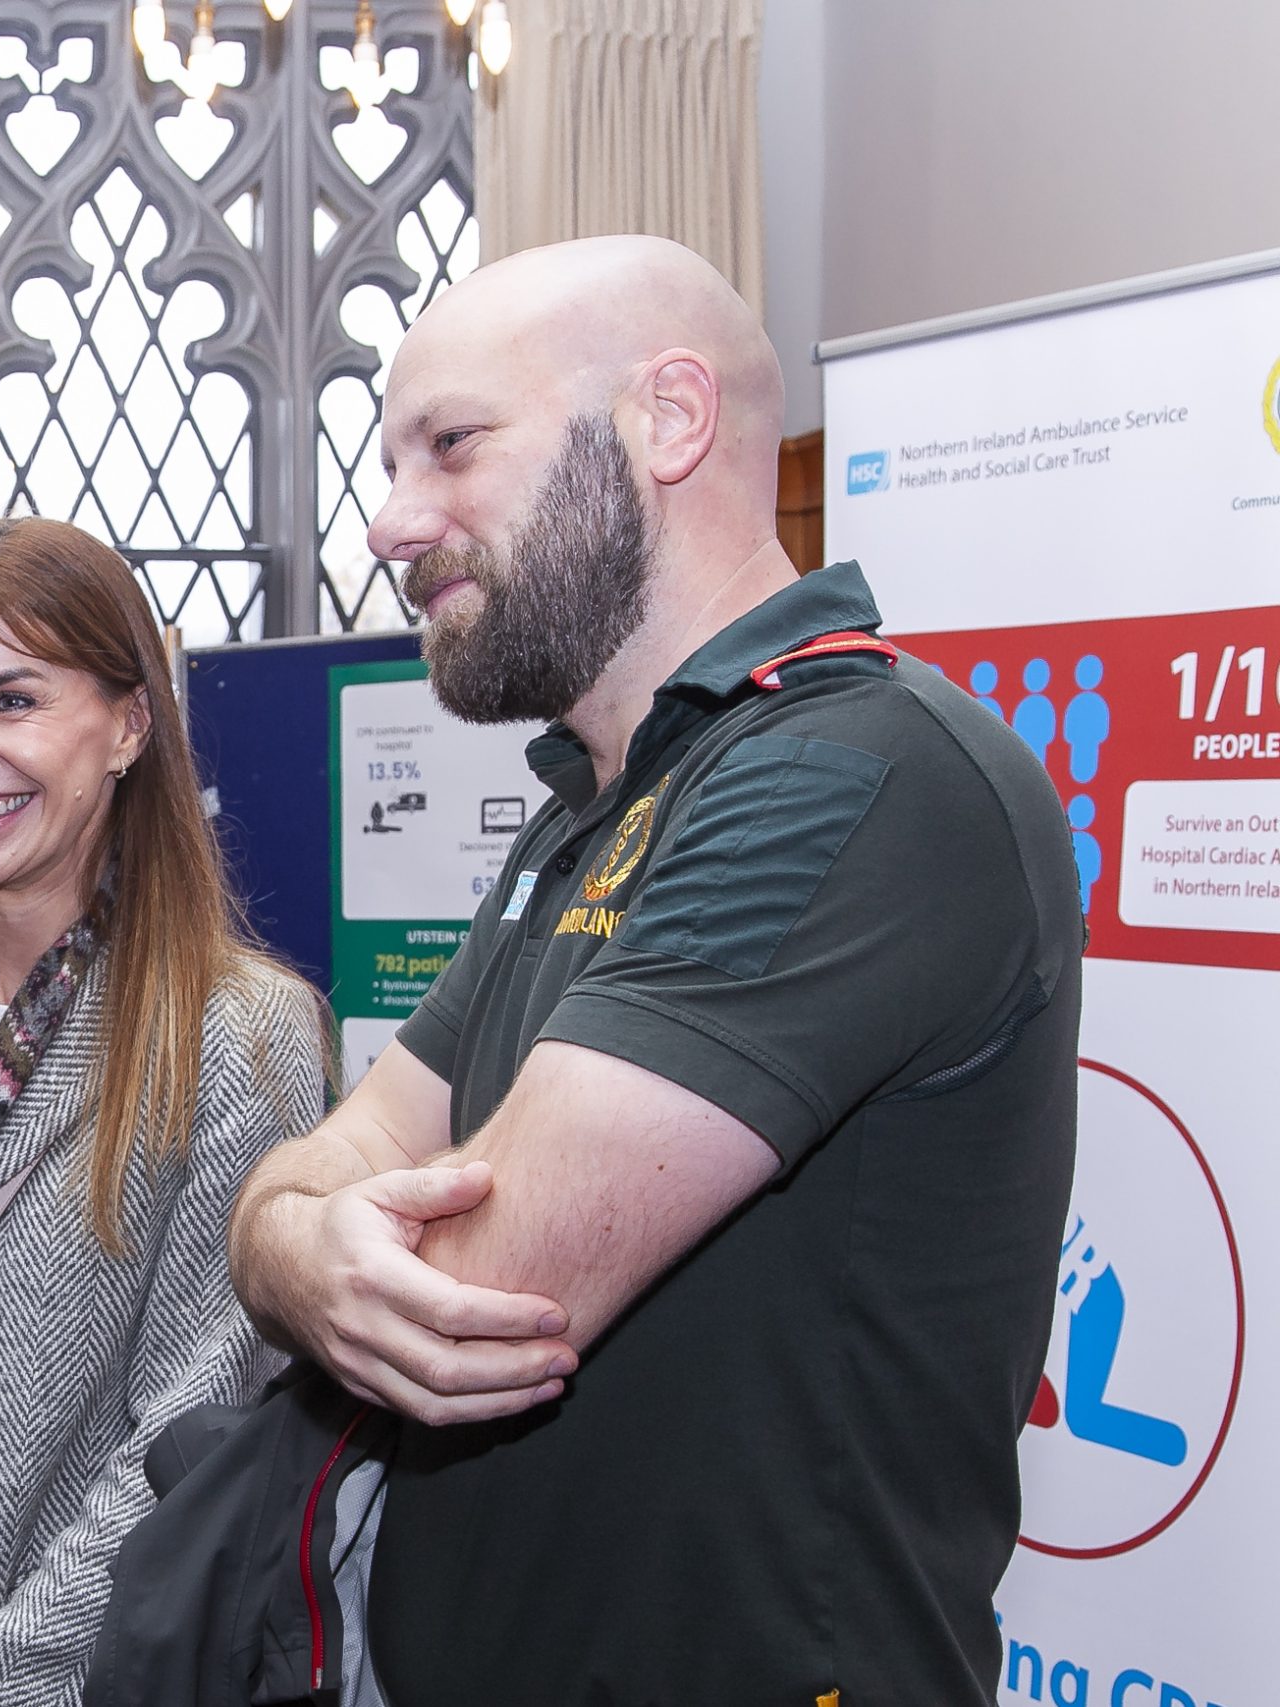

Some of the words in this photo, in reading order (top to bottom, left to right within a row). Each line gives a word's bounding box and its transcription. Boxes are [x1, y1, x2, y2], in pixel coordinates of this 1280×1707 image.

[900, 440, 968, 461] Northern
[972, 427, 1026, 451] Ireland
[1030, 417, 1120, 443] Ambulance
[1125, 405, 1188, 429] Service
[850, 461, 882, 484] HSC
[899, 467, 947, 489] Health
[951, 462, 981, 482] and
[985, 455, 1030, 478] Social
[1034, 452, 1069, 472] Care
[1072, 446, 1111, 466] Trust
[1193, 732, 1280, 760] PEOPLE
[368, 760, 421, 780] 13.5%
[1166, 814, 1222, 832] Survive
[1226, 818, 1245, 832] an
[1141, 846, 1206, 867] Hospital
[1209, 846, 1266, 865] Cardiac
[1154, 877, 1169, 894] in
[1173, 878, 1241, 897] Northern
[406, 930, 457, 944] UTSTEIN
